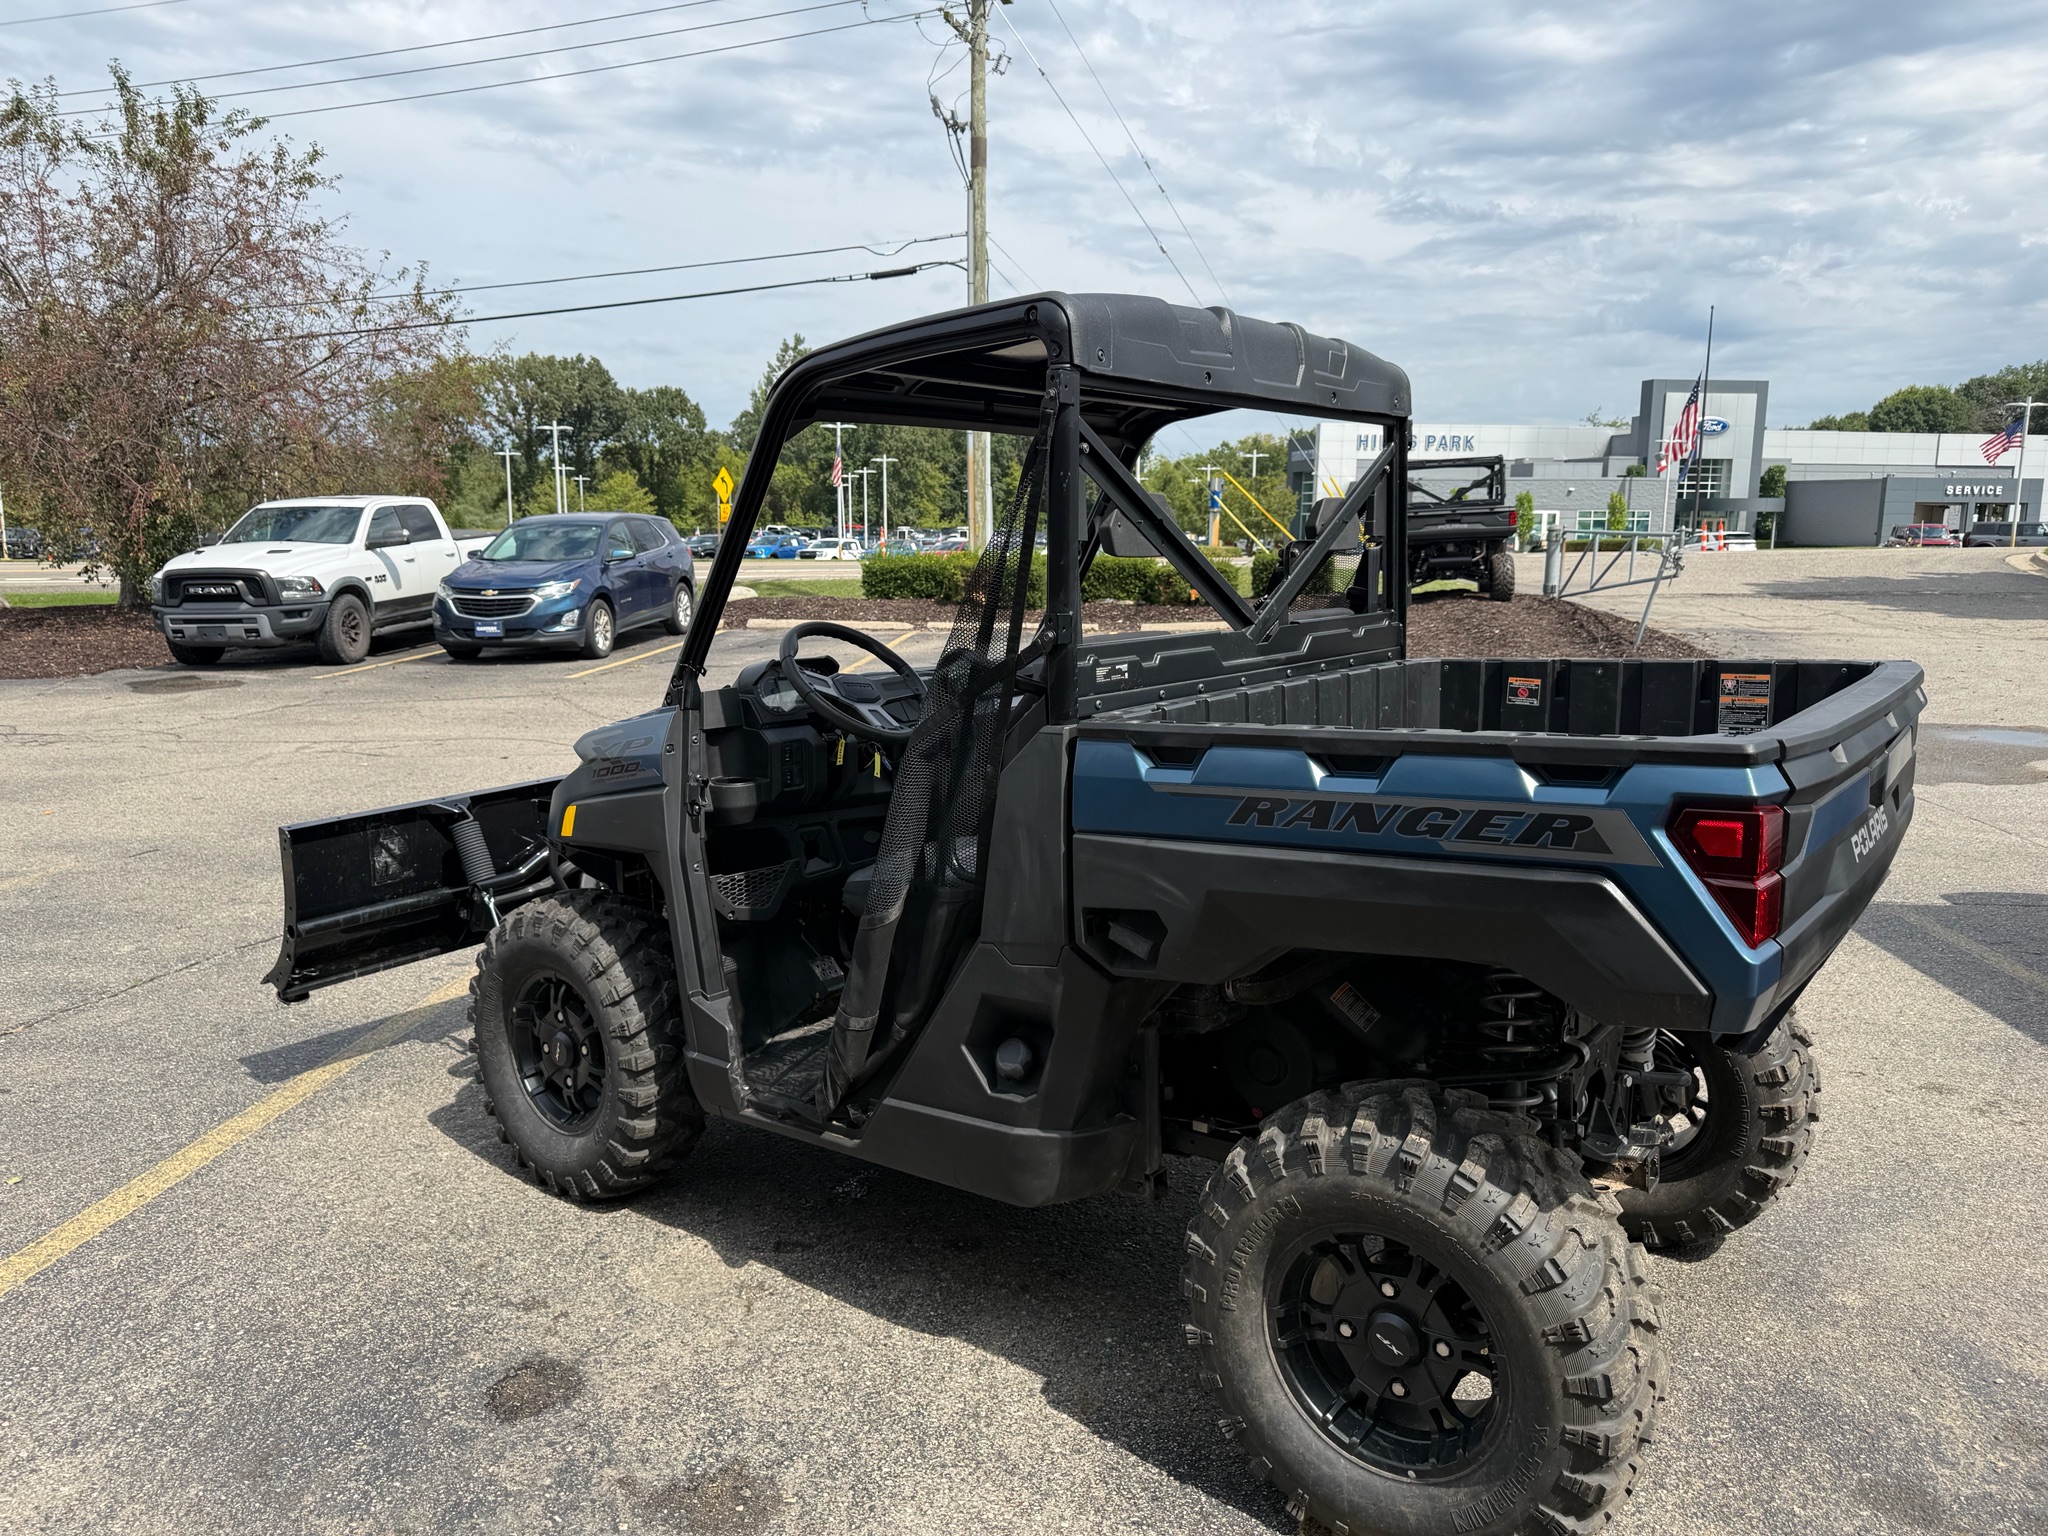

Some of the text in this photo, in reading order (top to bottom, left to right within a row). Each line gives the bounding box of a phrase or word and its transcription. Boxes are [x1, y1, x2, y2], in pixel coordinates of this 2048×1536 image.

[1703, 420, 1723, 431] Ford
[1357, 434, 1475, 451] HIS PARK
[1945, 485, 2003, 496] SERVICE
[186, 585, 235, 595] RAM
[589, 735, 656, 765] XP
[592, 761, 642, 779] 1000
[1225, 795, 1595, 850] RANGER
[1850, 804, 1889, 863] POLARIS
[1221, 1206, 1285, 1312] PRO ARMOR
